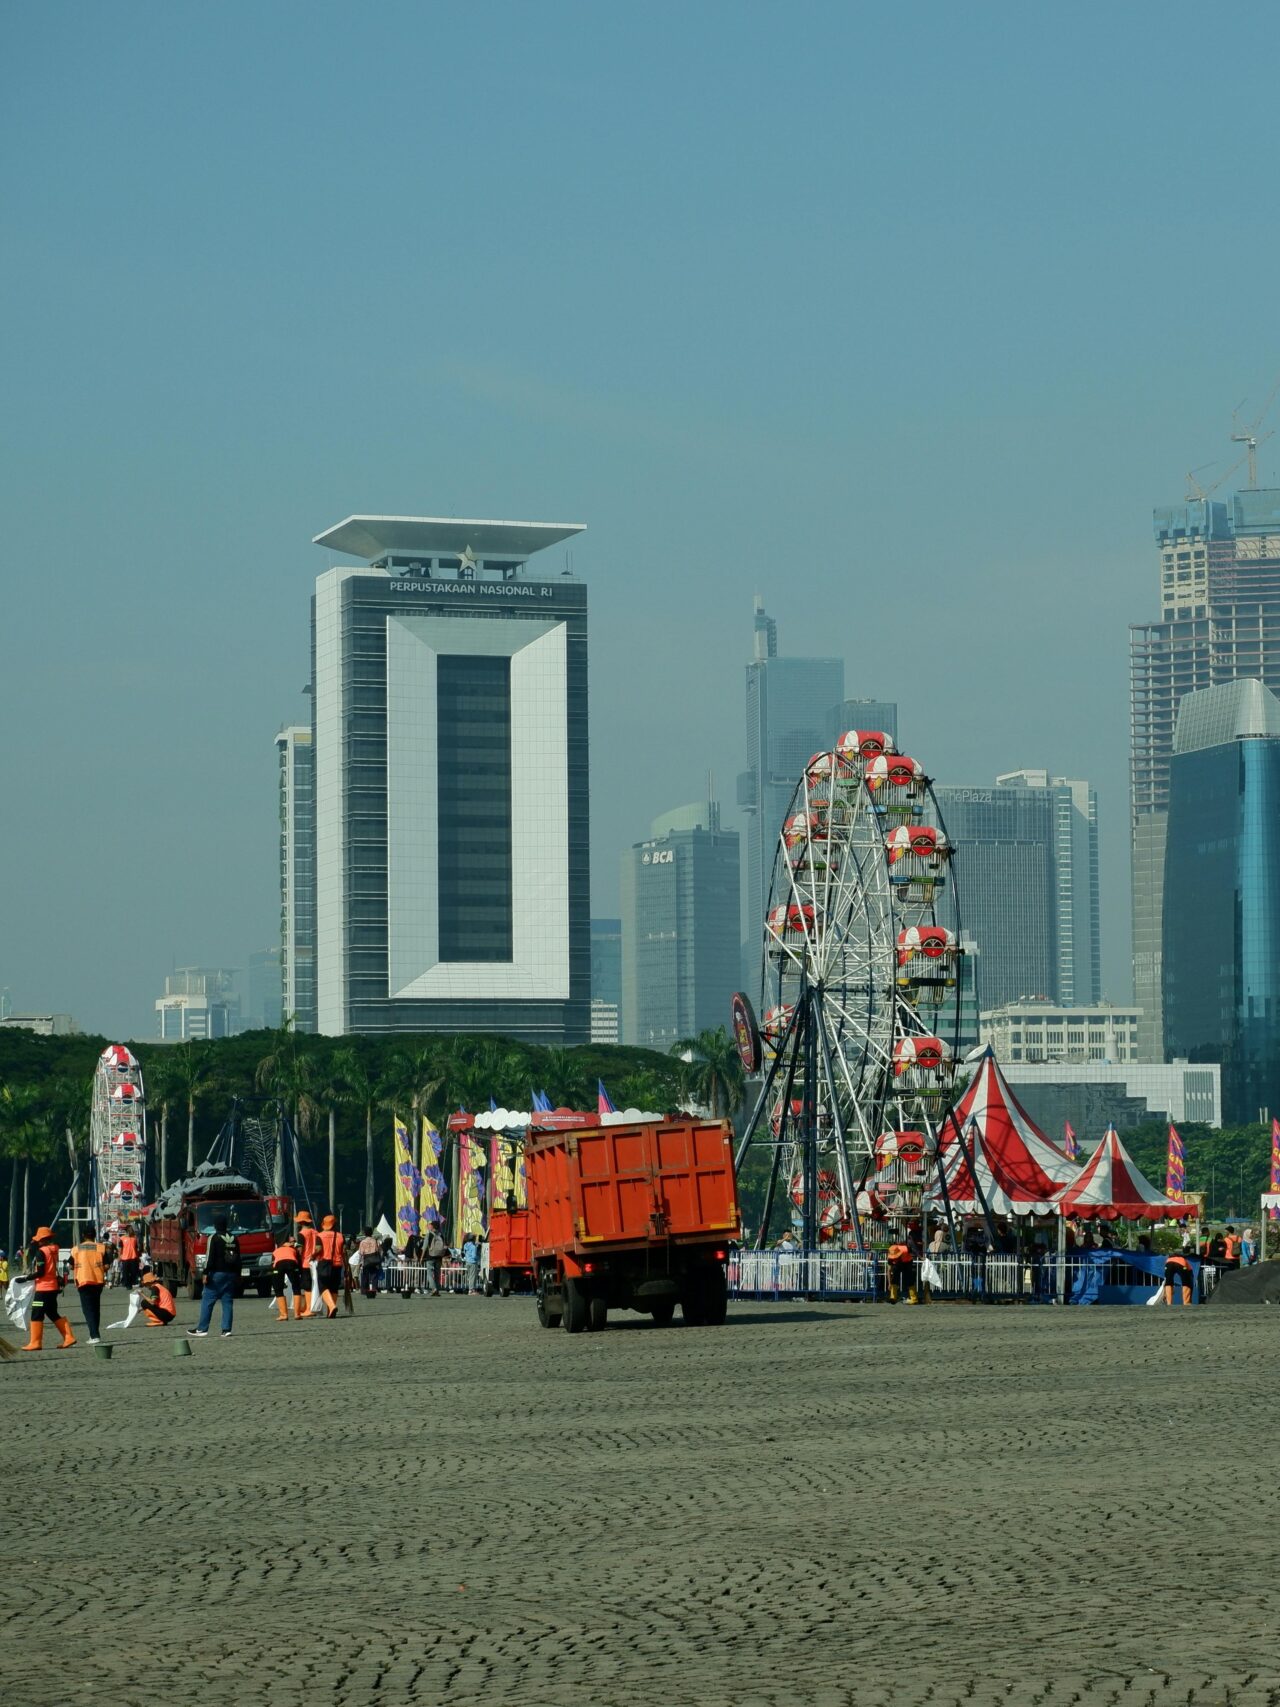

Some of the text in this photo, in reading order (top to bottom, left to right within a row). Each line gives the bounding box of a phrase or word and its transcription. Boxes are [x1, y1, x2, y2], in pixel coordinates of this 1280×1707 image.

[390, 581, 552, 597] PERPUSTAKAAN NASIONAL RI
[652, 850, 673, 863] BCA
